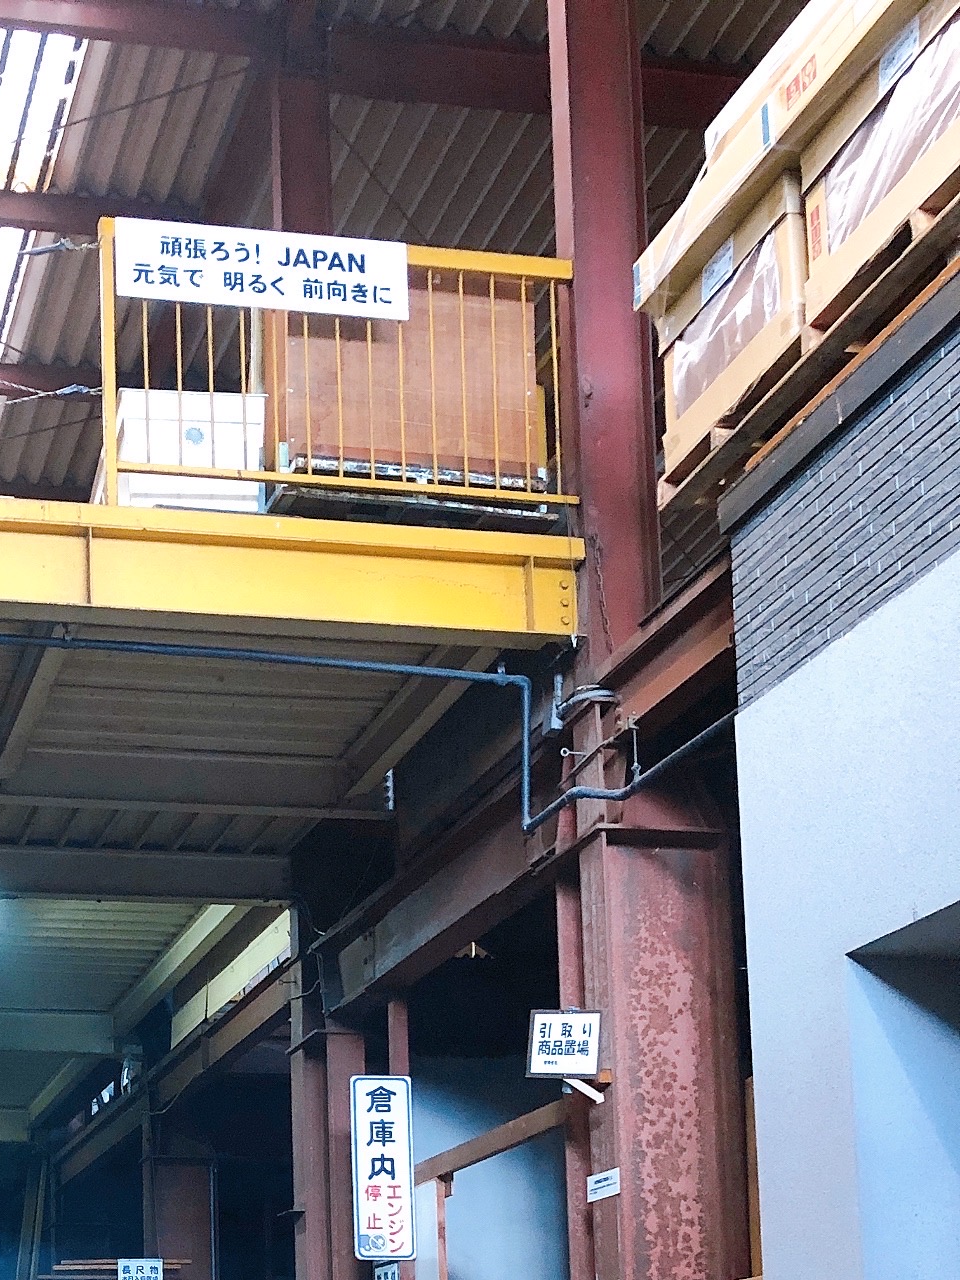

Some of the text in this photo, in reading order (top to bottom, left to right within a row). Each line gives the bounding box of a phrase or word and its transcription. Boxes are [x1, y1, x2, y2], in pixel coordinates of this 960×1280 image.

[278, 247, 365, 273] JAPAN
[132, 263, 392, 304] 元気で 明るく 前向きに
[537, 1039, 589, 1056] 商品置場
[365, 1085, 397, 1181] 倉庫内
[364, 1184, 384, 1230] 停止
[386, 1184, 405, 1253] エンジン
